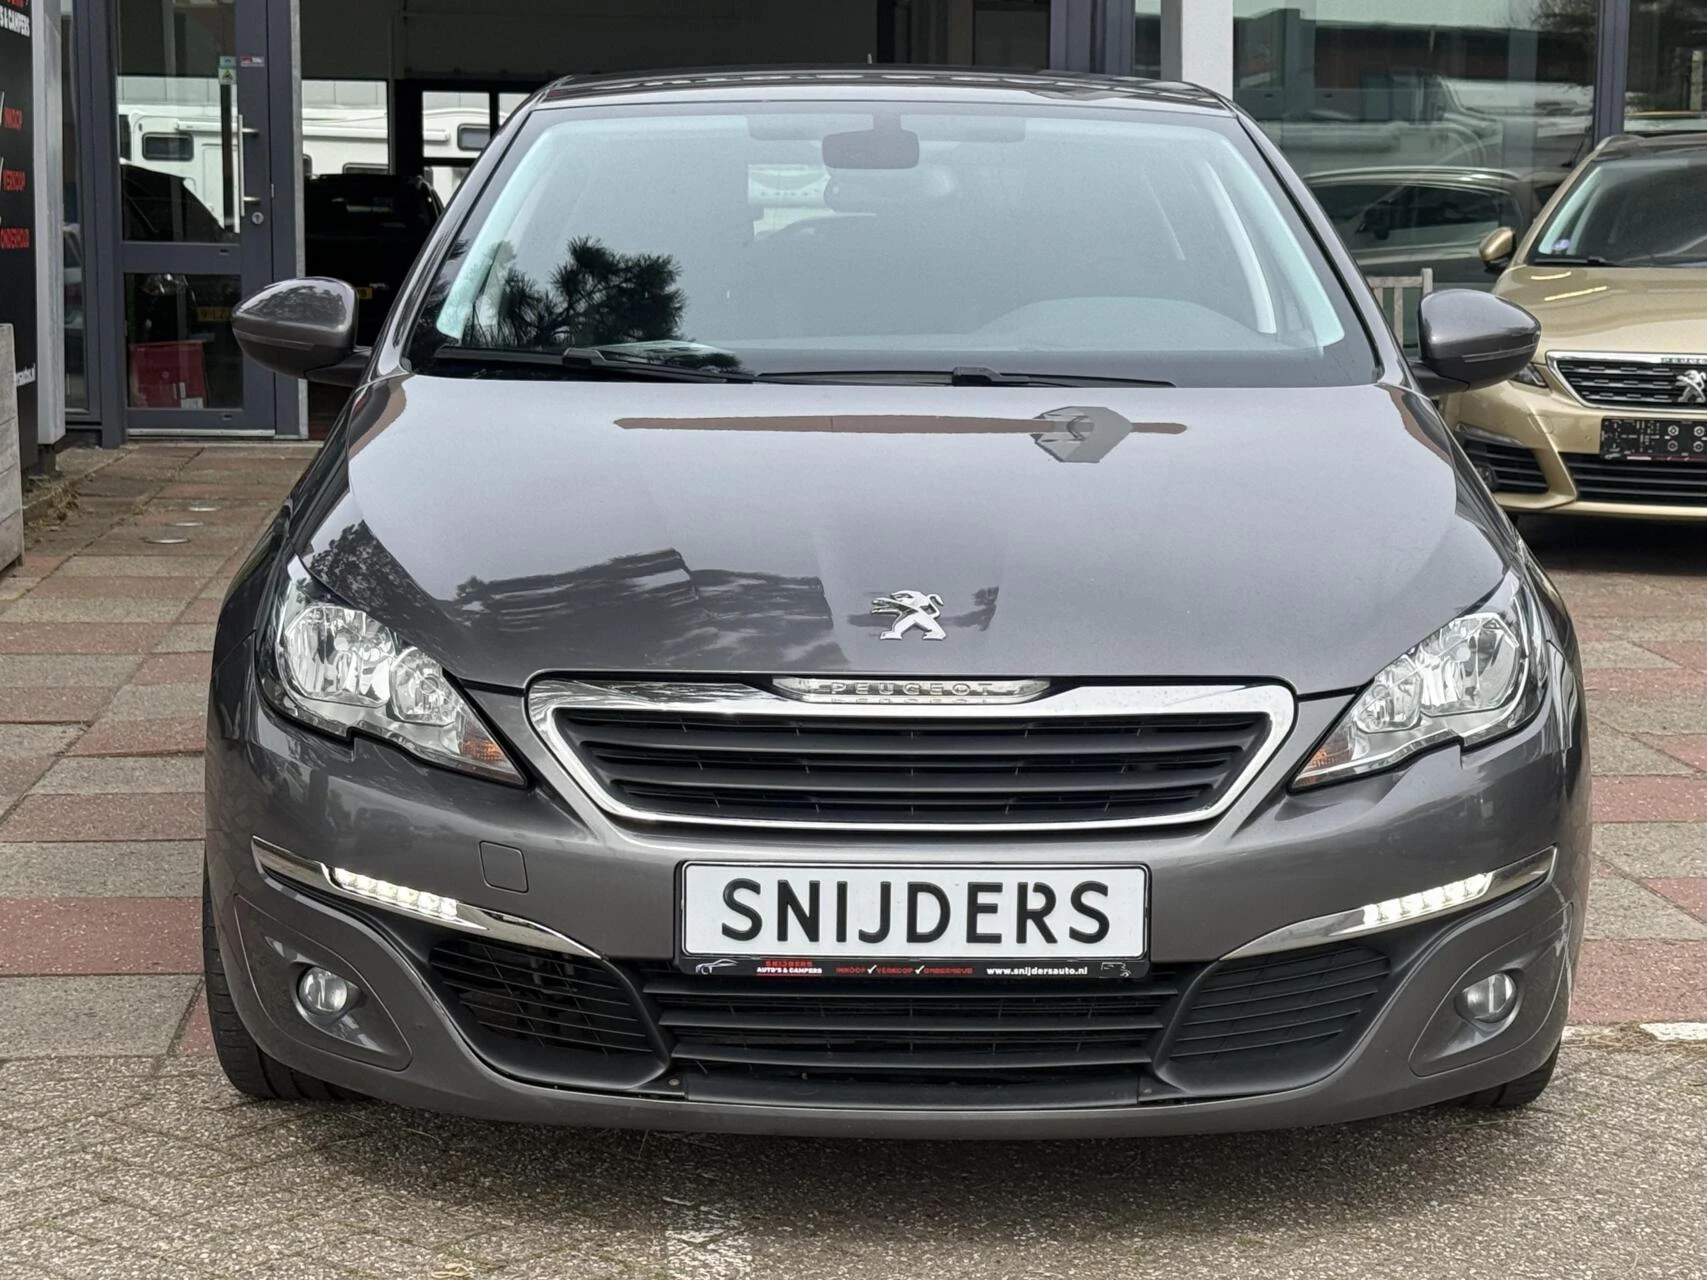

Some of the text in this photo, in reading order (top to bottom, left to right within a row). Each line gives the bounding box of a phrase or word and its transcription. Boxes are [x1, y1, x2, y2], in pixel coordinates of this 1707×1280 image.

[831, 682, 992, 695] PEUGEOT
[721, 877, 1111, 945] SNIJDERS
[986, 966, 1088, 976] www.snijdersauto.nl
